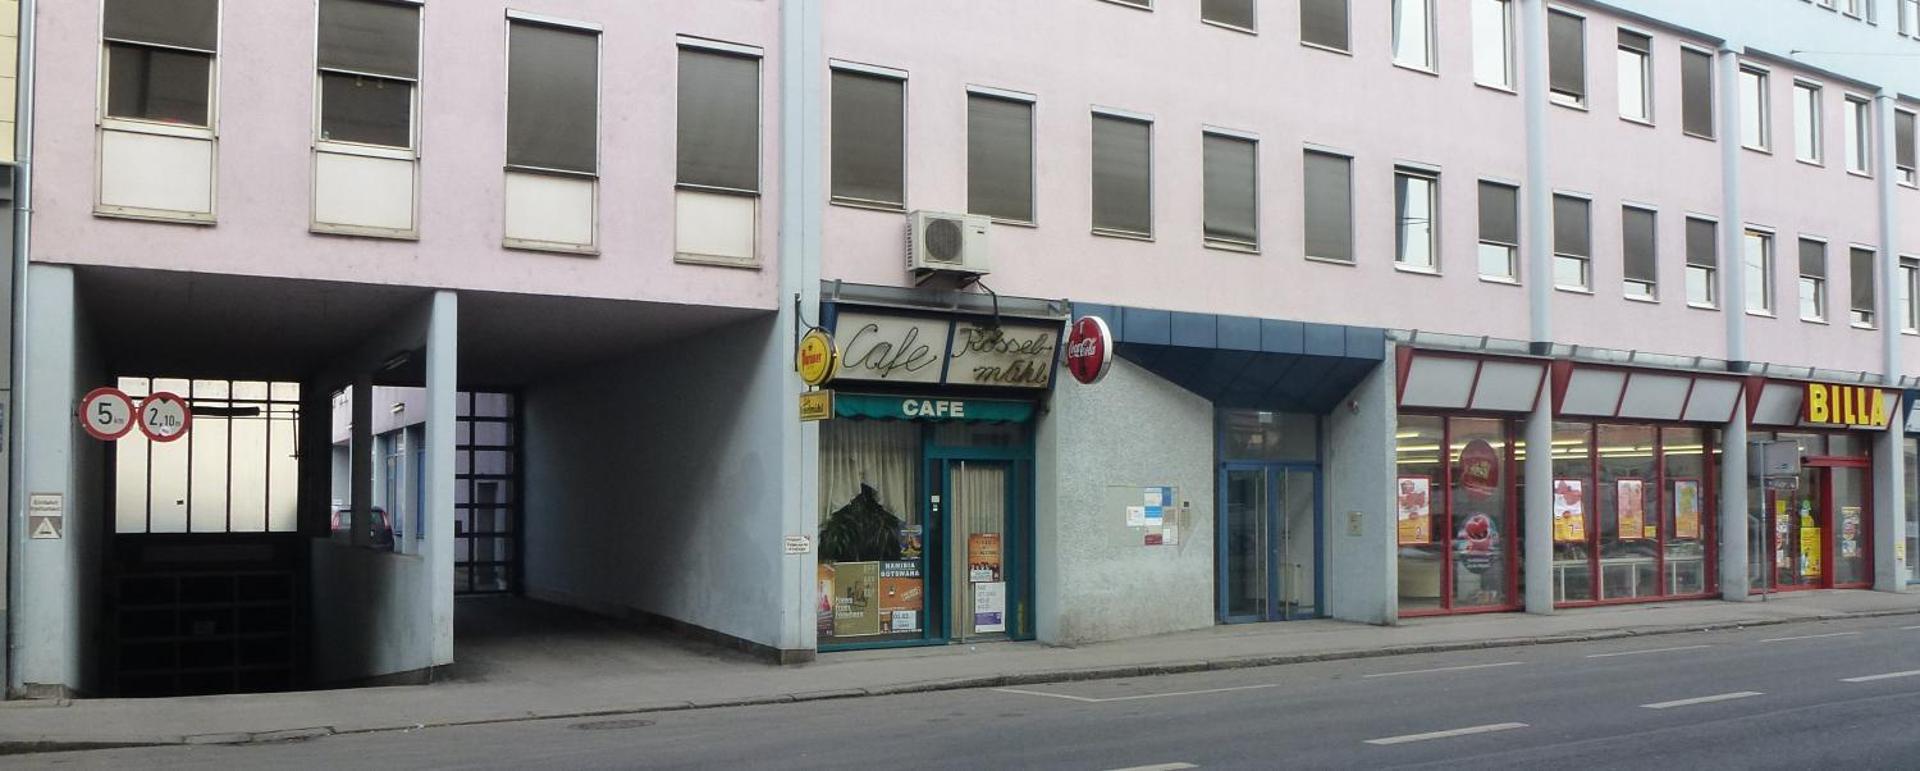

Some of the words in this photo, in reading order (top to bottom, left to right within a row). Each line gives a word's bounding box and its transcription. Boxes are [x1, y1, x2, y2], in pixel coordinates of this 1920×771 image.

[843, 323, 938, 378] Cafe
[98, 402, 113, 425] 5
[902, 399, 964, 417] CAFE
[1809, 383, 1886, 427] BILLA
